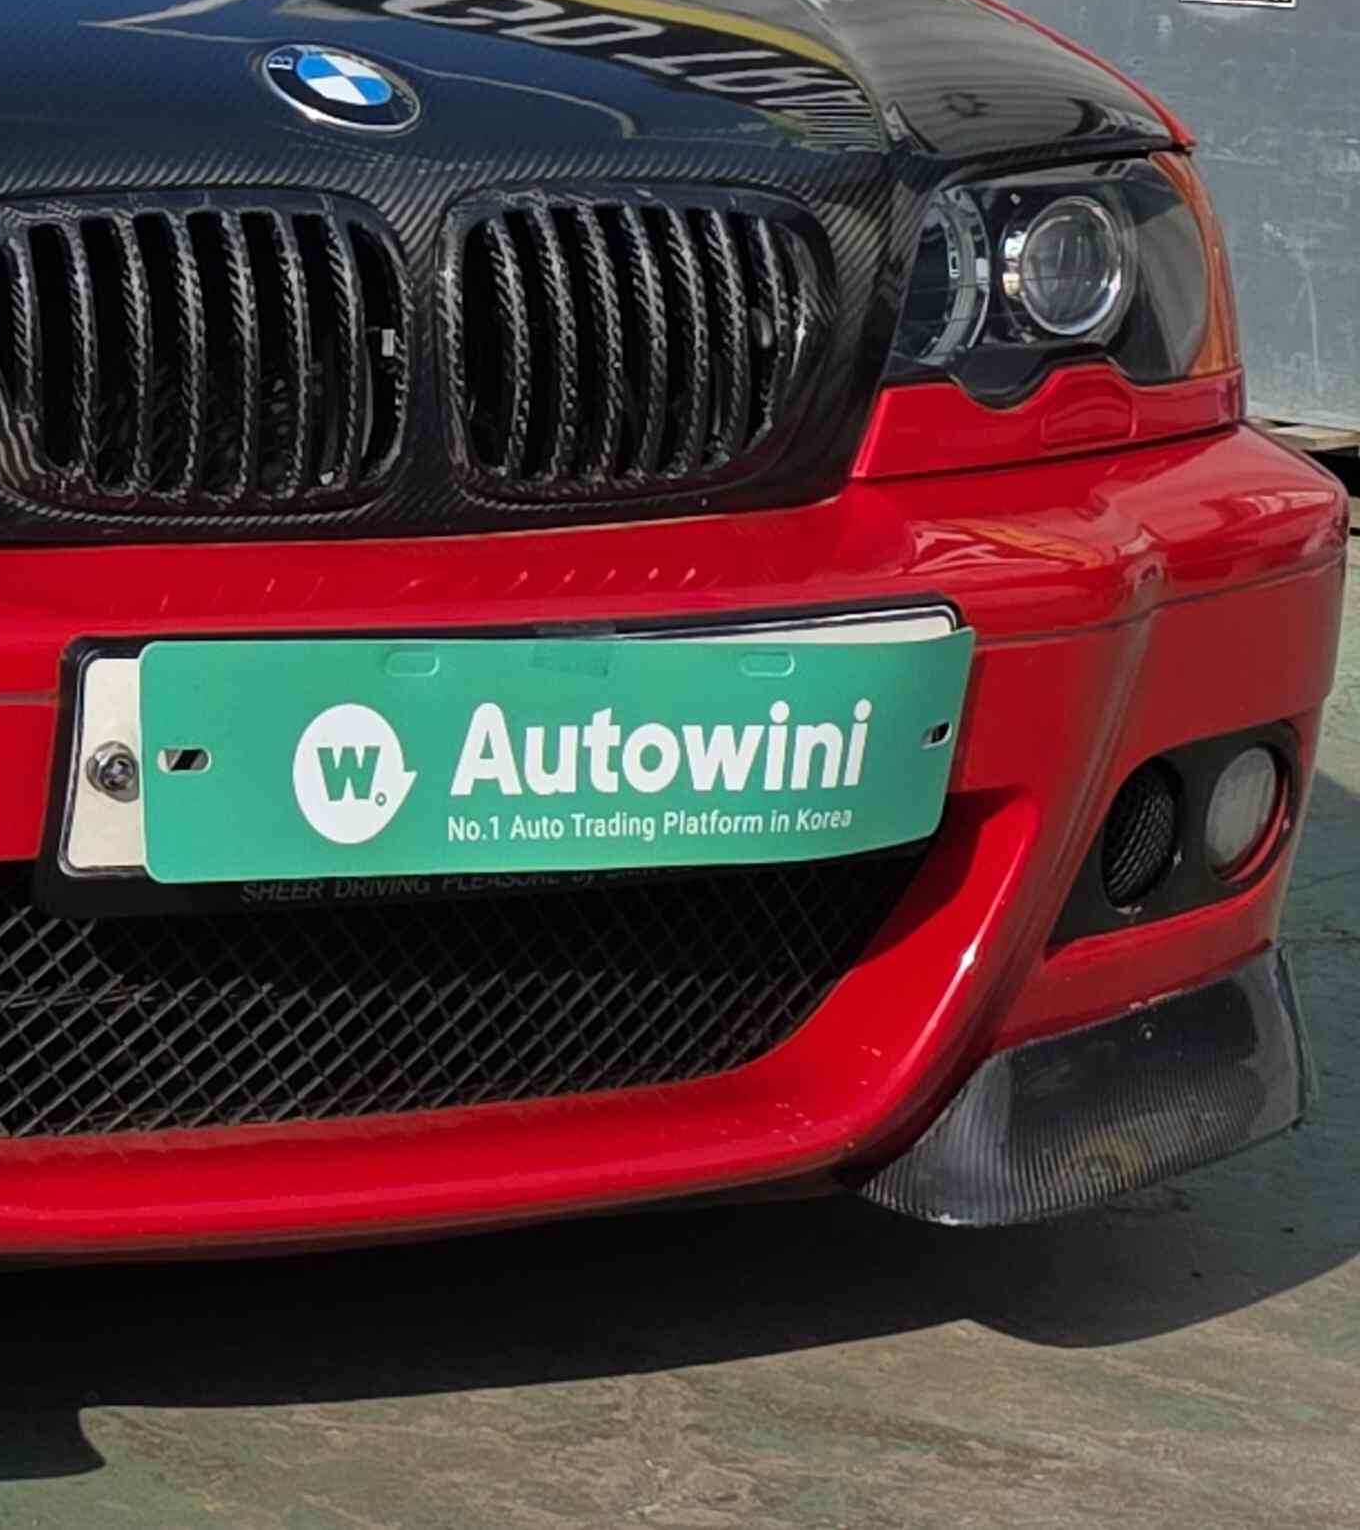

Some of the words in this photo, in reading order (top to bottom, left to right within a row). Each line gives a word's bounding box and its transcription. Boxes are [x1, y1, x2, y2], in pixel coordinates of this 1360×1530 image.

[450, 699, 873, 795] Autowini
[447, 815, 500, 841] No.1
[510, 815, 564, 840] Auto
[571, 811, 656, 842] Trading
[663, 808, 764, 836] Platform
[770, 808, 790, 832] in
[796, 807, 854, 831] Korea
[240, 881, 324, 903] SHEER
[335, 876, 432, 899] DRIVING
